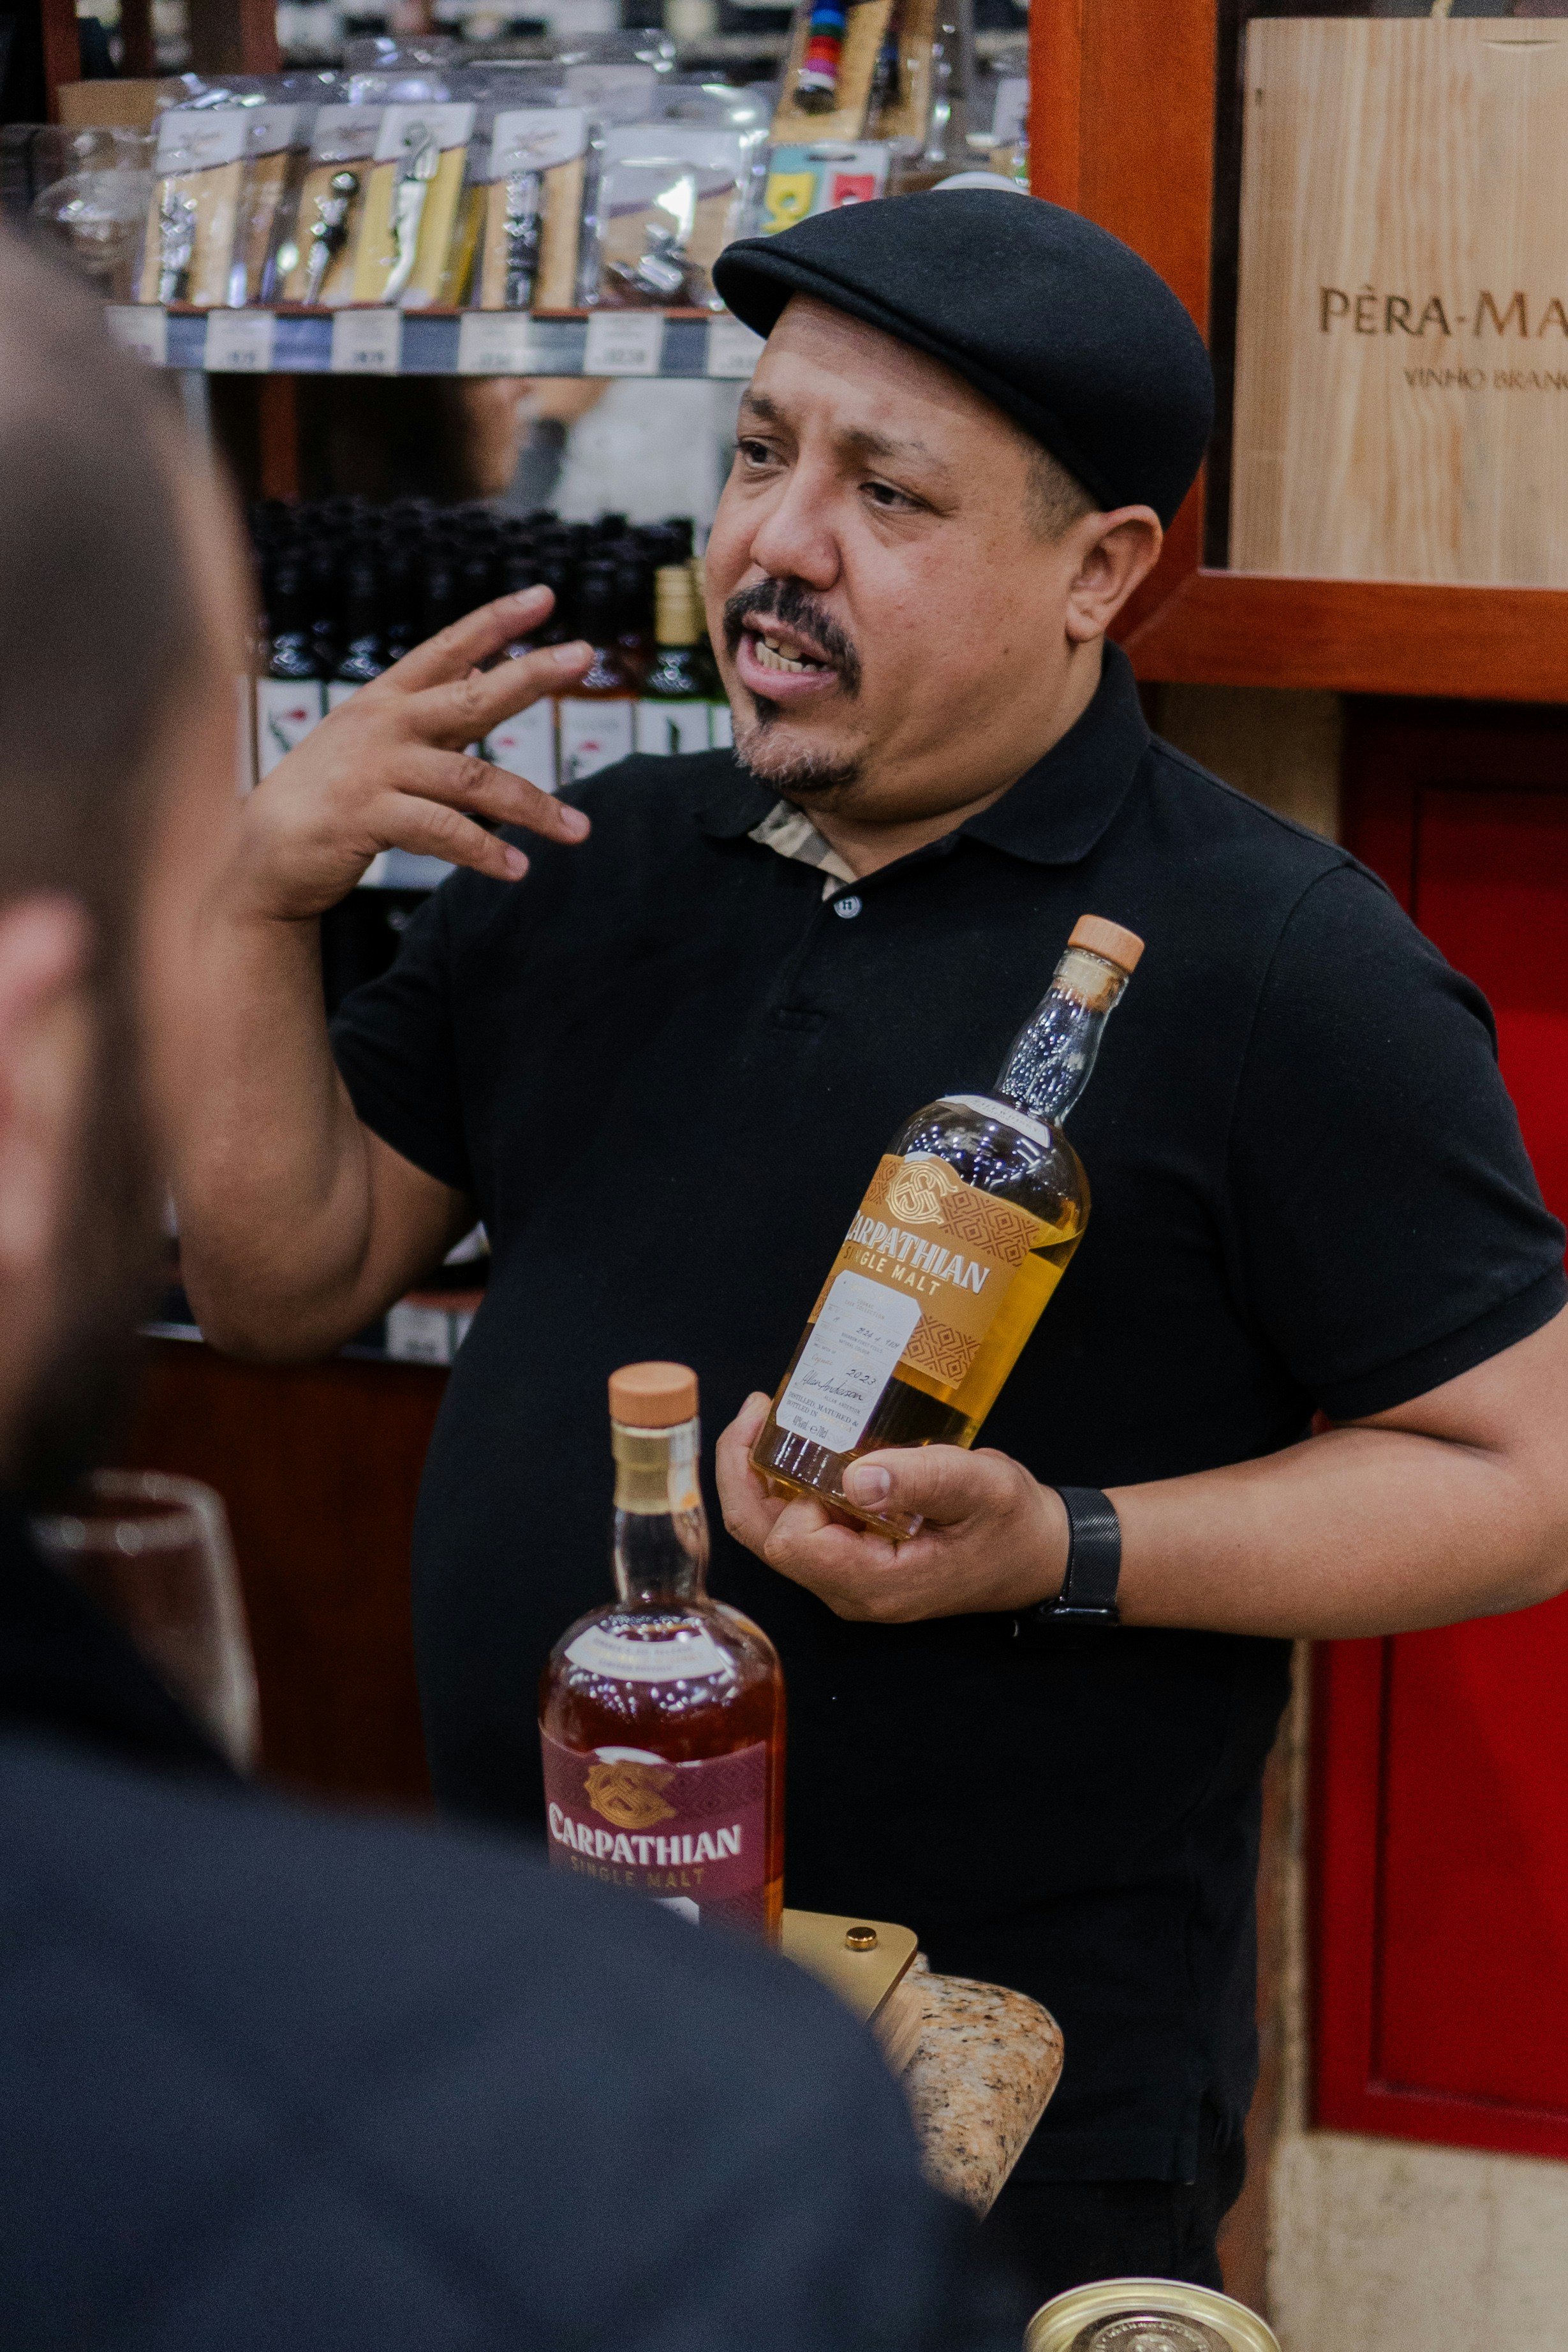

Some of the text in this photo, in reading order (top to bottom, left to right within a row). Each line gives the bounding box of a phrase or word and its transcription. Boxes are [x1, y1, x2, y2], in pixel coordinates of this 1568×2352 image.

[1404, 367, 1488, 390] VINHO
[843, 1246, 941, 1296] SINGLE MALT
[845, 1369, 876, 1386] 2023
[786, 1400, 810, 1414] BOTTLED
[788, 1391, 816, 1407] DISTILLED,
[817, 1404, 852, 1424] MATURED
[838, 1402, 861, 1414] ANDERSON
[549, 1801, 742, 1866] CARPATHIAN
[570, 1855, 704, 1888] SINGLE MALT
